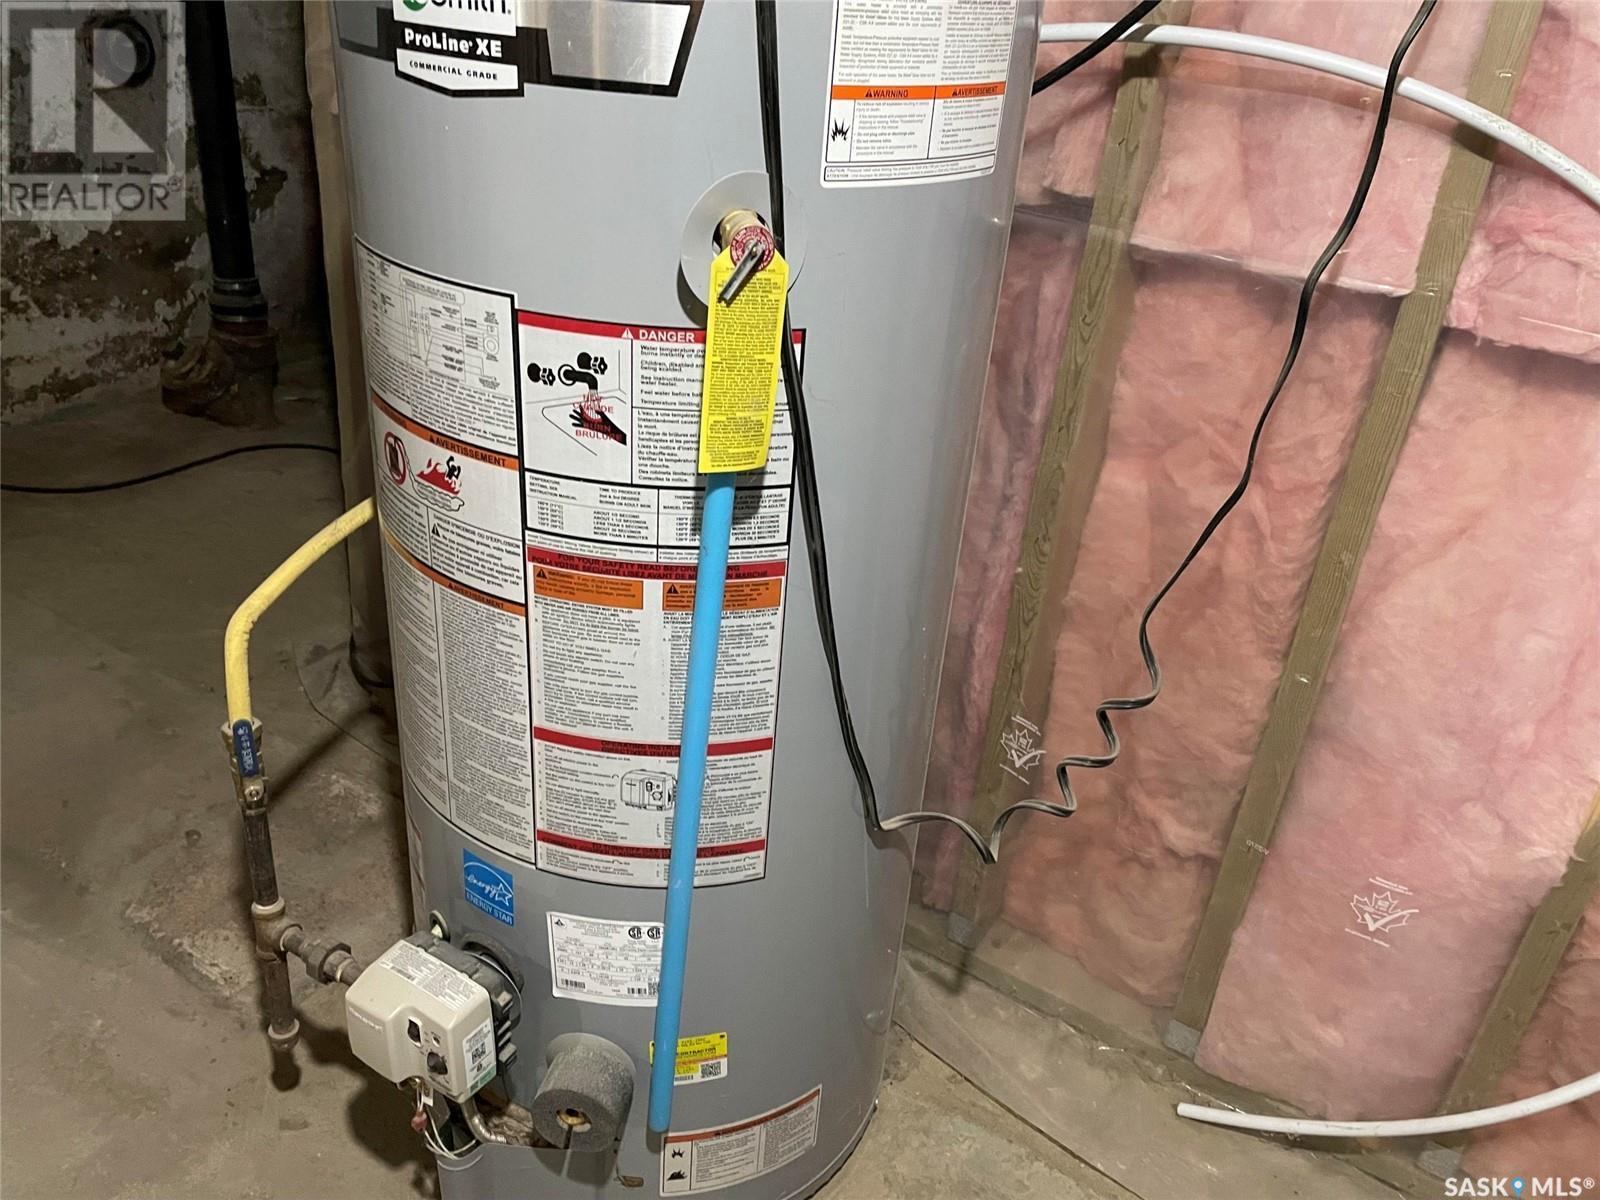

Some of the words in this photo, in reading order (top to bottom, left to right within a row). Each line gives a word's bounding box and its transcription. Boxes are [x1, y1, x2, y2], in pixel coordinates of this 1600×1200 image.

[475, 37, 503, 58] XE
[409, 60, 462, 76] COMMERCIAL
[466, 69, 498, 80] GRADE
[872, 89, 909, 98] WARNING
[639, 329, 695, 342] DANGER
[435, 437, 506, 468] AVERTISSEMENT
[494, 908, 513, 926] STAR
